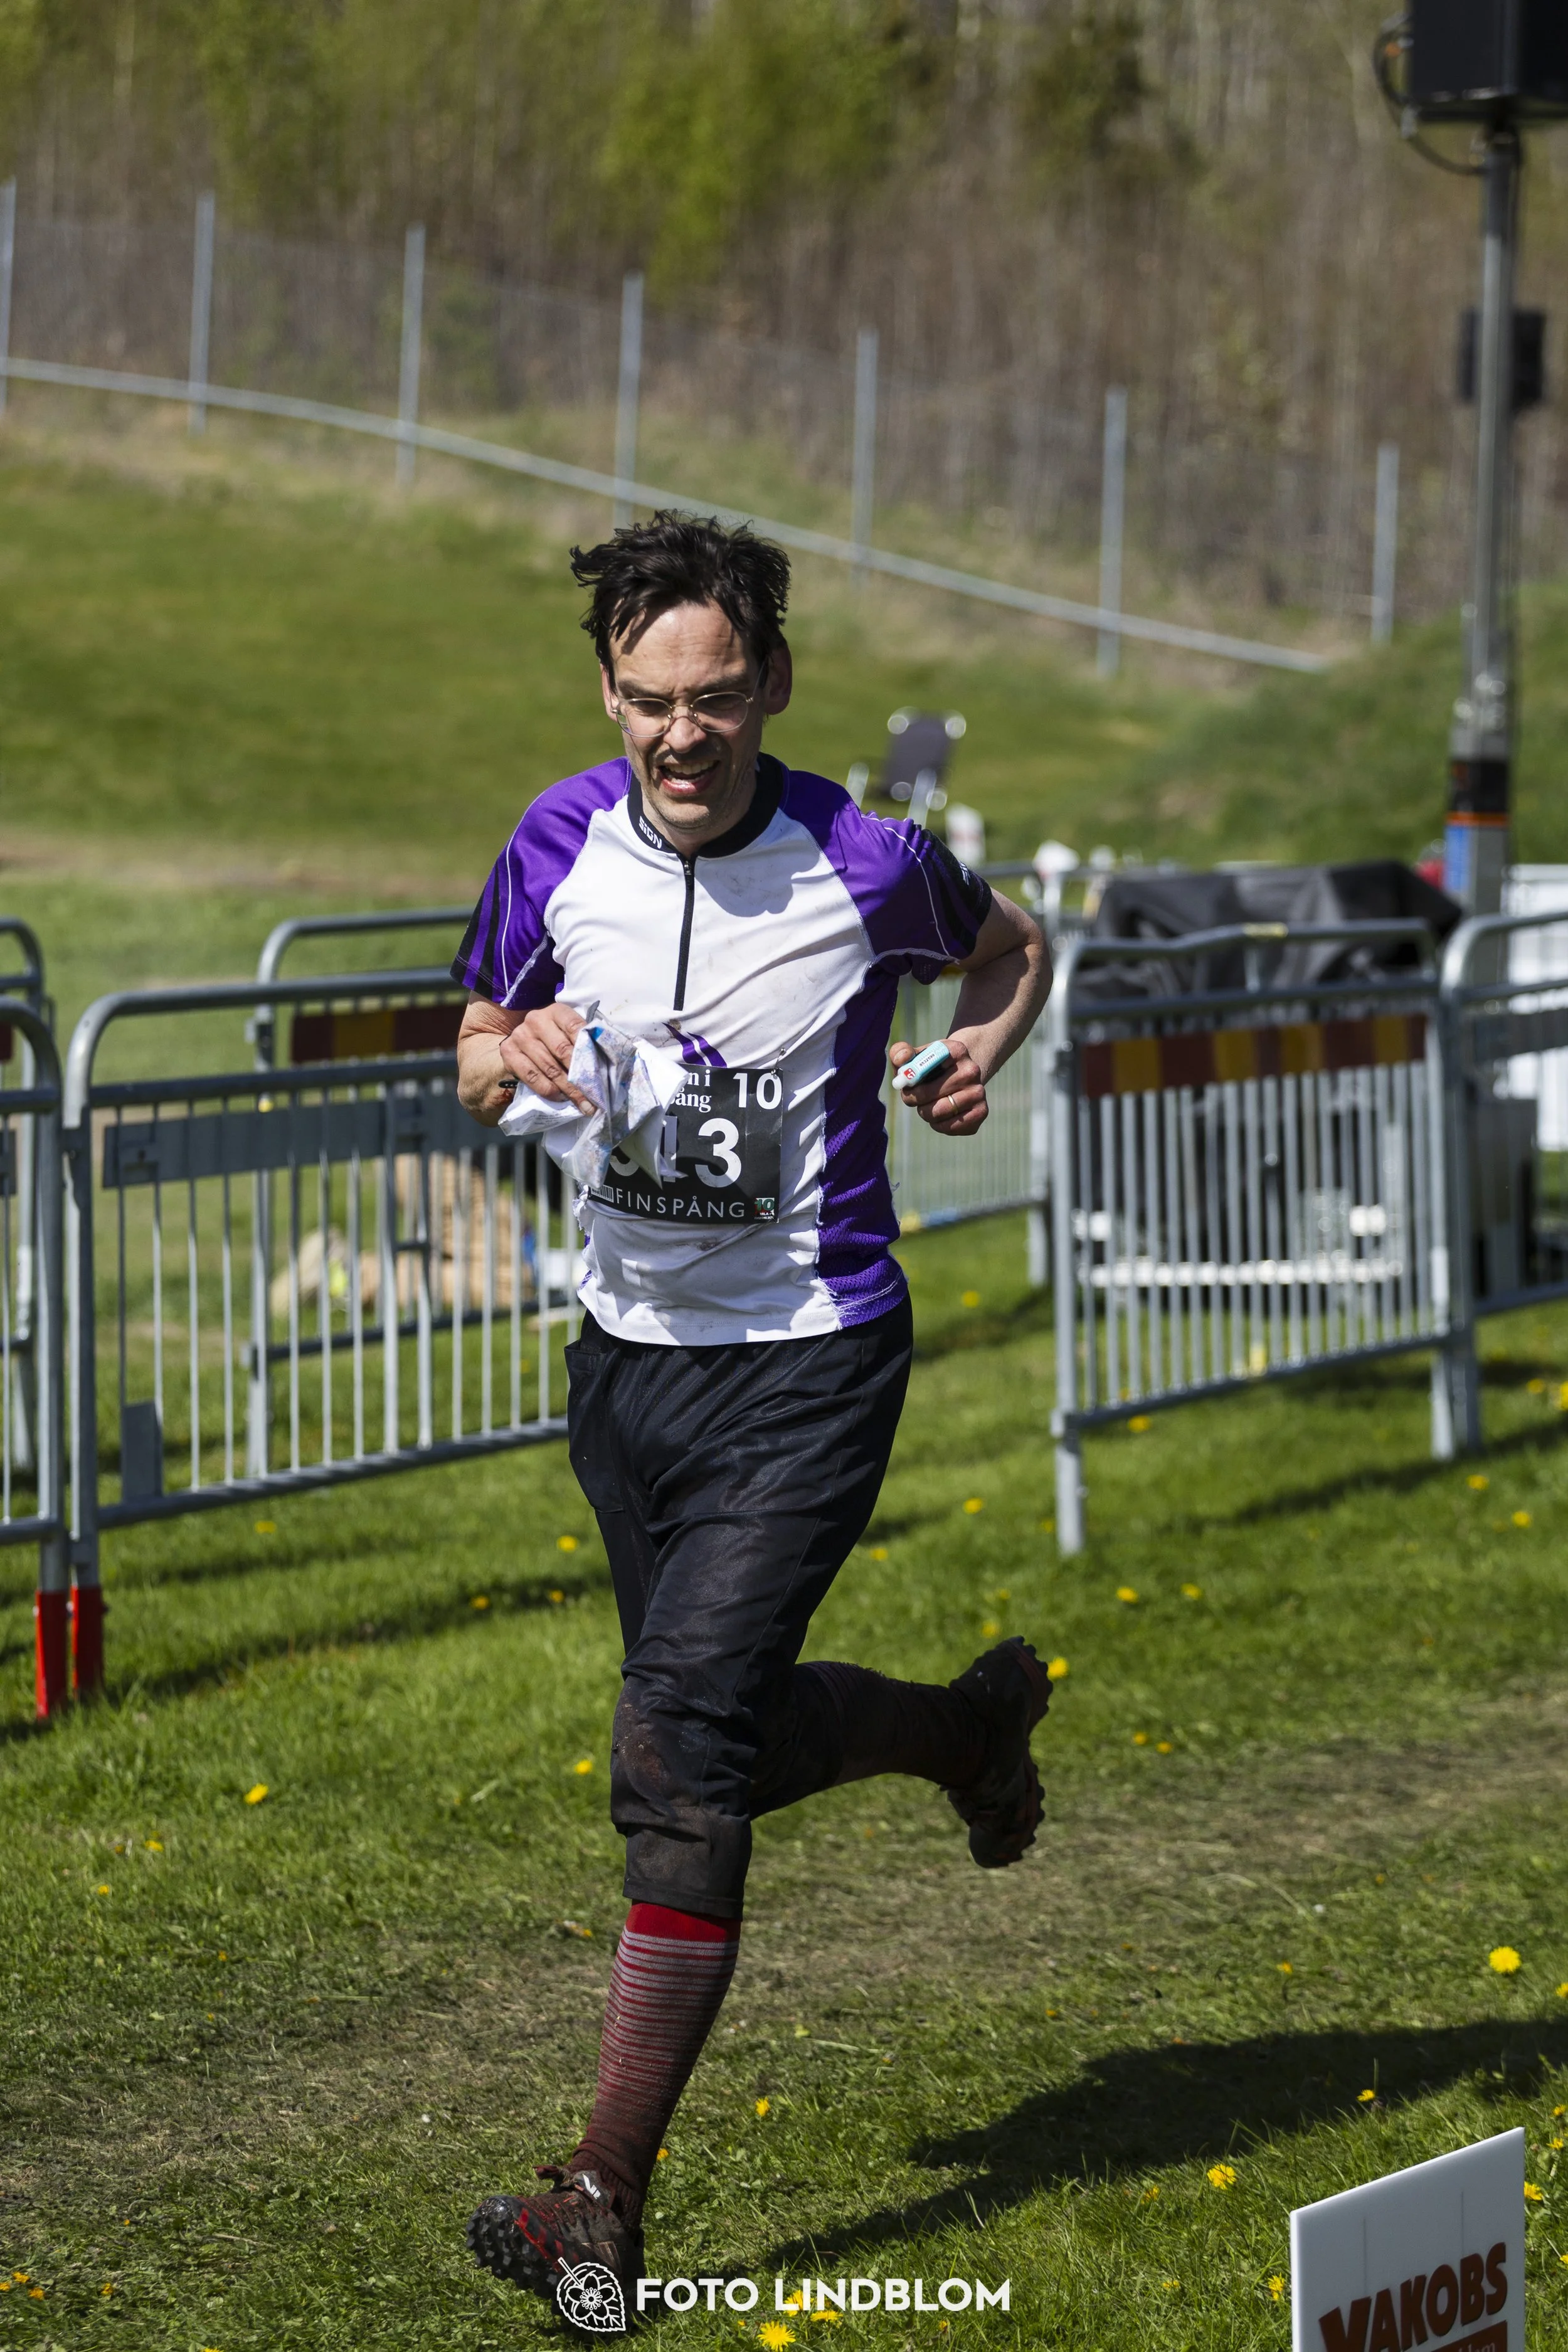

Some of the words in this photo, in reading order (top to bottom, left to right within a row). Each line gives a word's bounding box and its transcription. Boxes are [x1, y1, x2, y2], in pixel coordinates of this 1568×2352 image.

[670, 1087, 712, 1113] ång
[733, 1073, 782, 1110] 10
[610, 1116, 741, 1188] 13
[616, 1188, 744, 1218] FINSPÅNG
